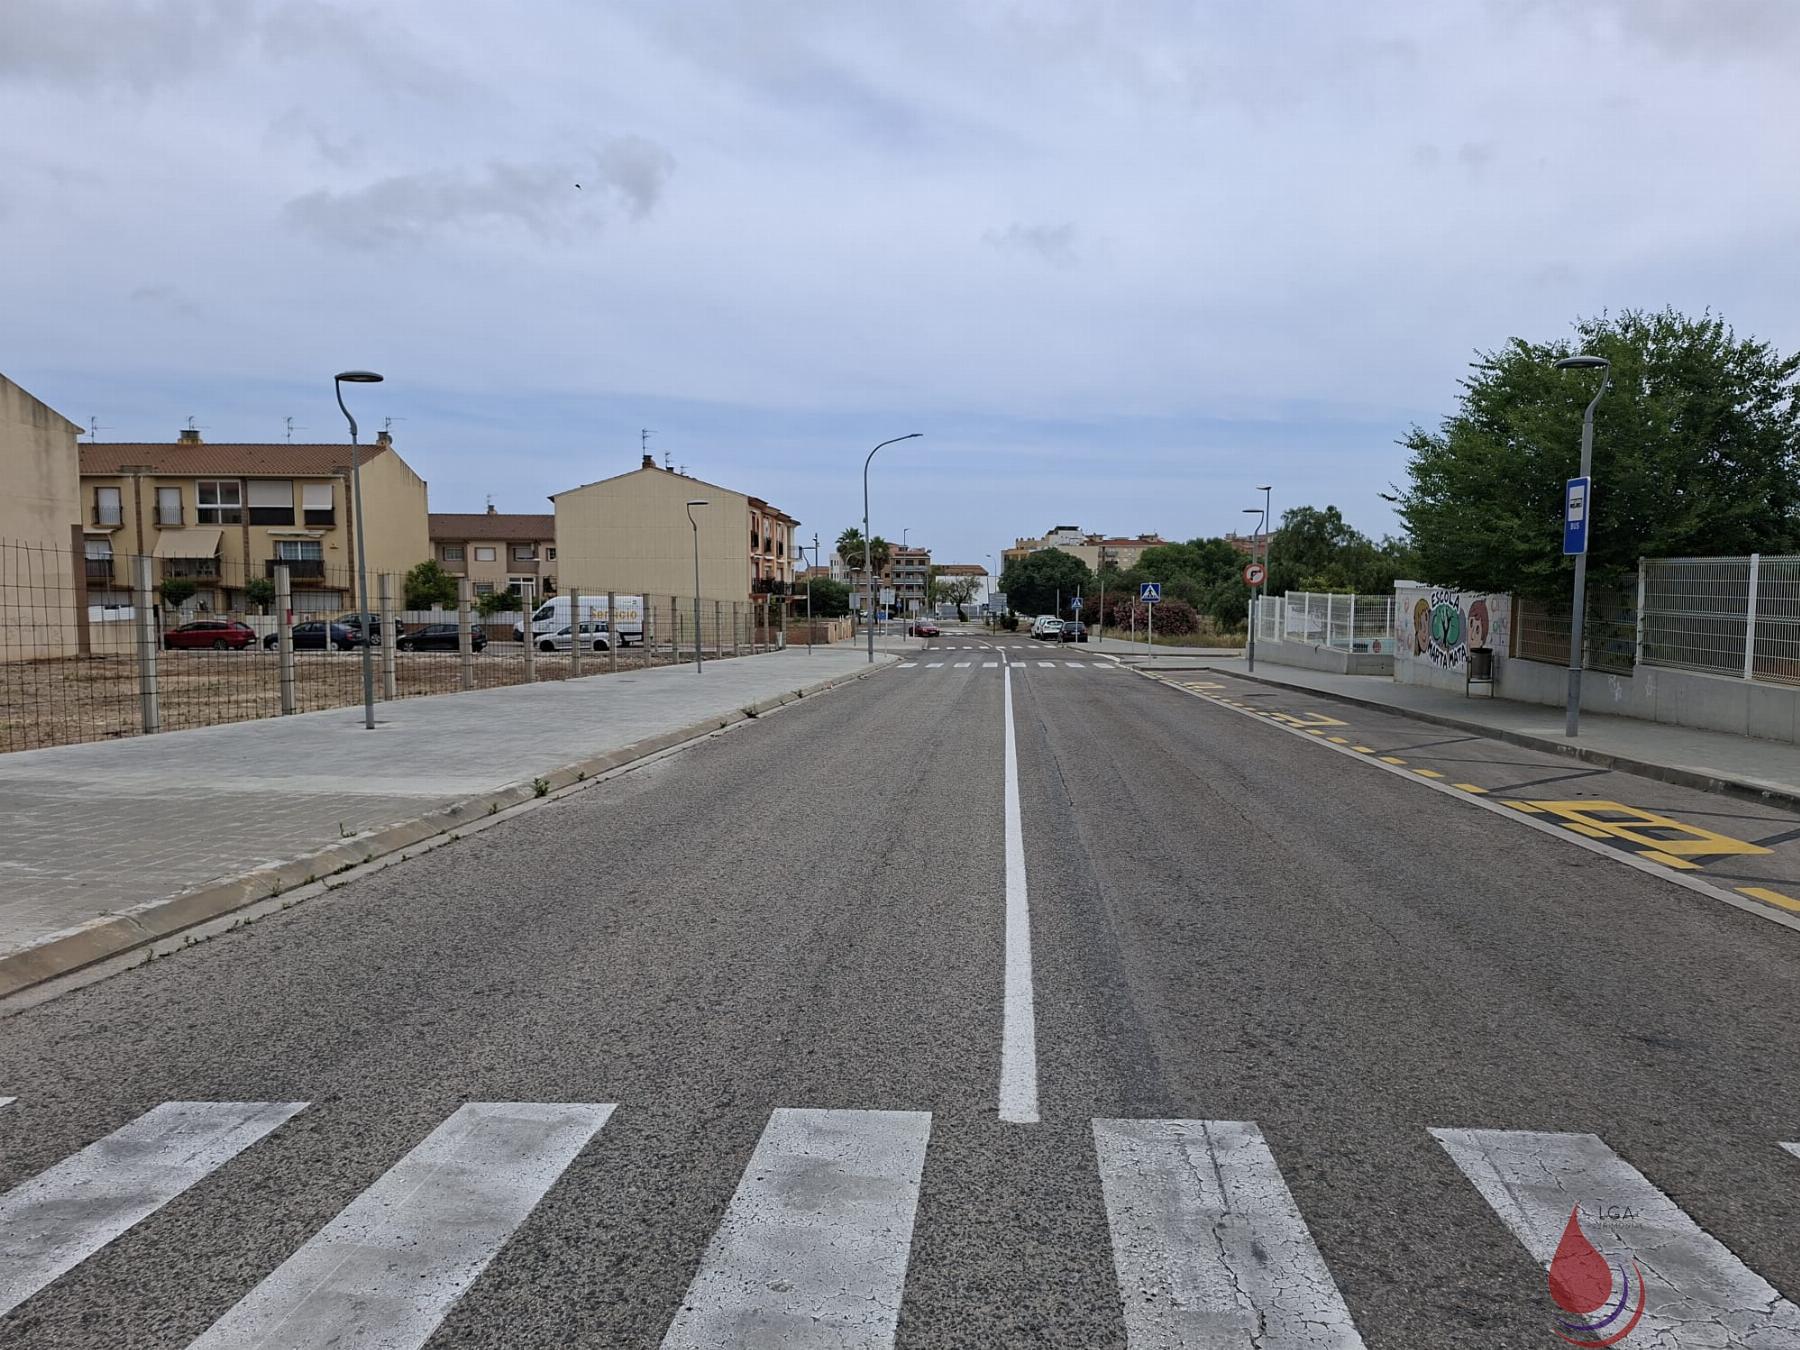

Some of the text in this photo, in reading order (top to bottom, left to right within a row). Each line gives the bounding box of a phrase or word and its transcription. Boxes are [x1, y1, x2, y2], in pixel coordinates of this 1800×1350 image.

[1570, 522, 1580, 530] BUS
[1431, 591, 1460, 611] ESCOLA
[1427, 641, 1469, 669] MARTA MATA
